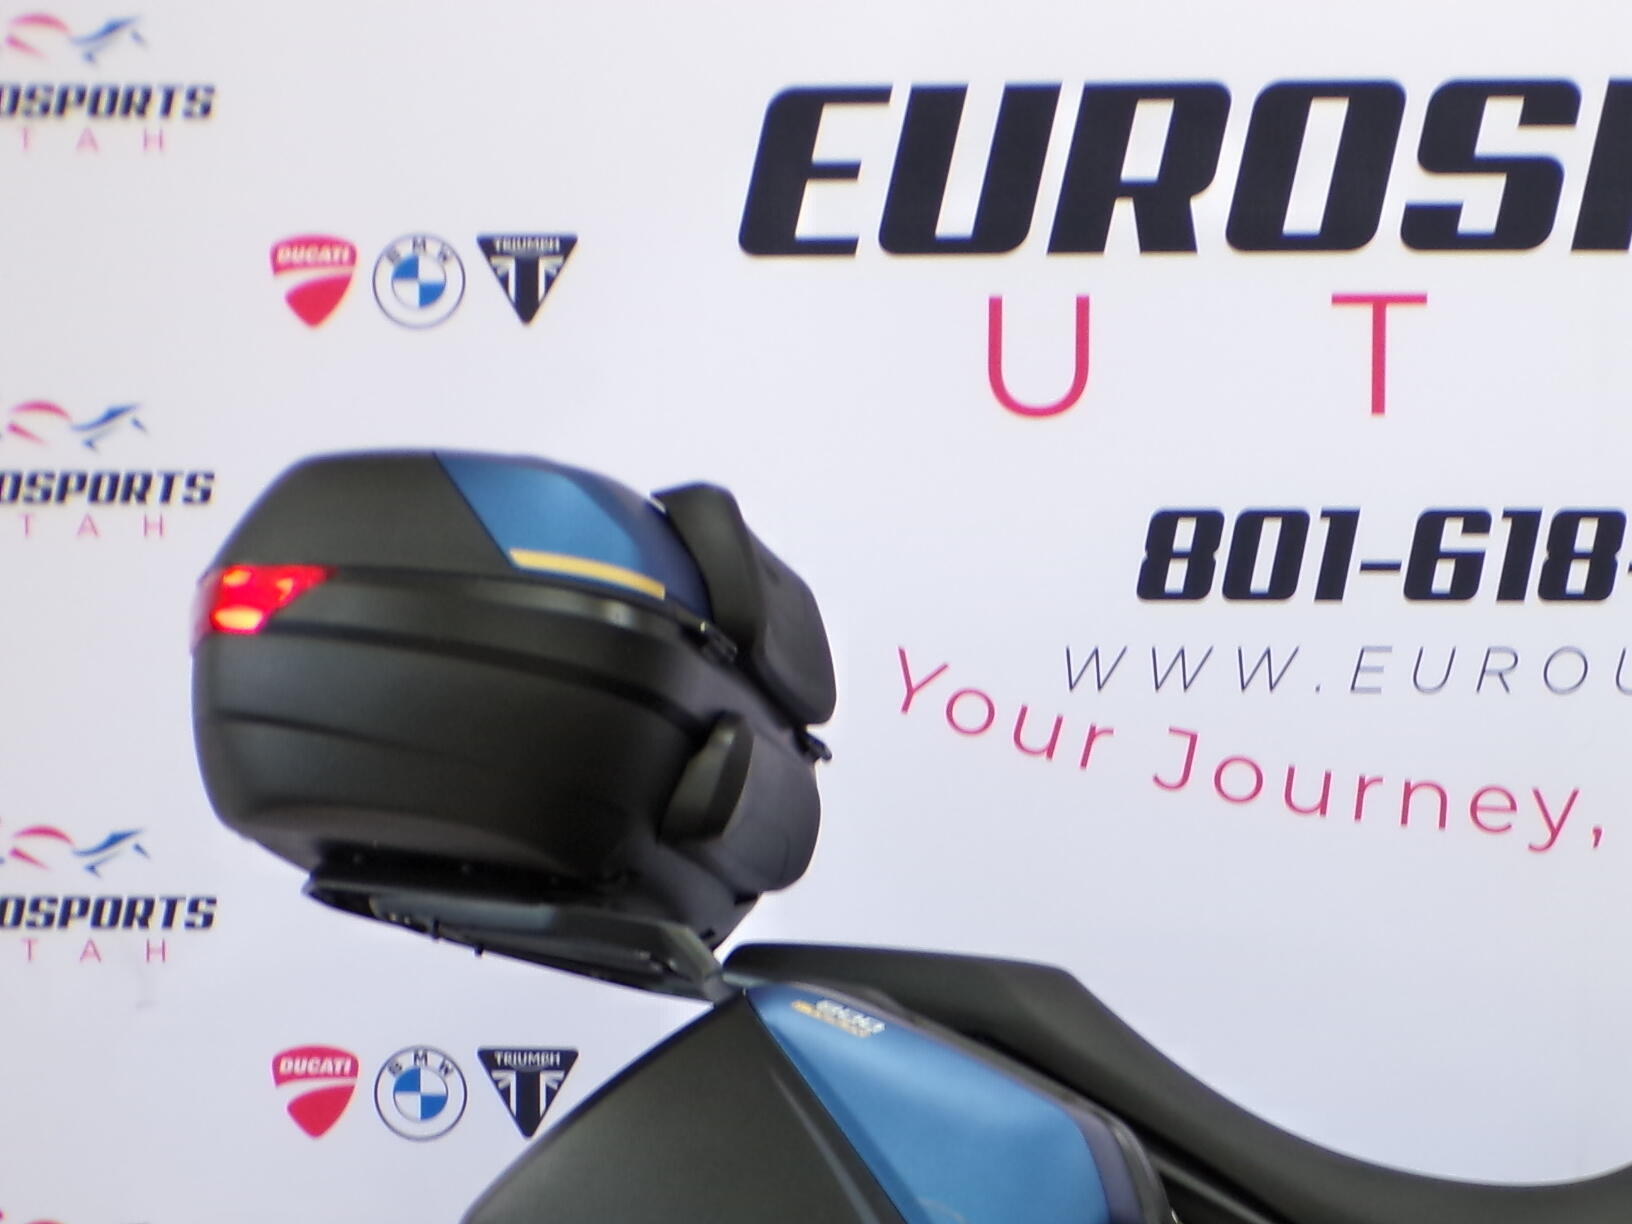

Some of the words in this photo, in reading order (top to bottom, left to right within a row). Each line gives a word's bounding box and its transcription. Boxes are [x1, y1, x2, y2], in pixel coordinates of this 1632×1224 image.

[277, 245, 350, 264] DUCATI
[898, 646, 1115, 771] Your
[1153, 726, 1603, 854] Journey,
[279, 1056, 352, 1077] DUCATI
[494, 1051, 561, 1067] TRIUMPH
